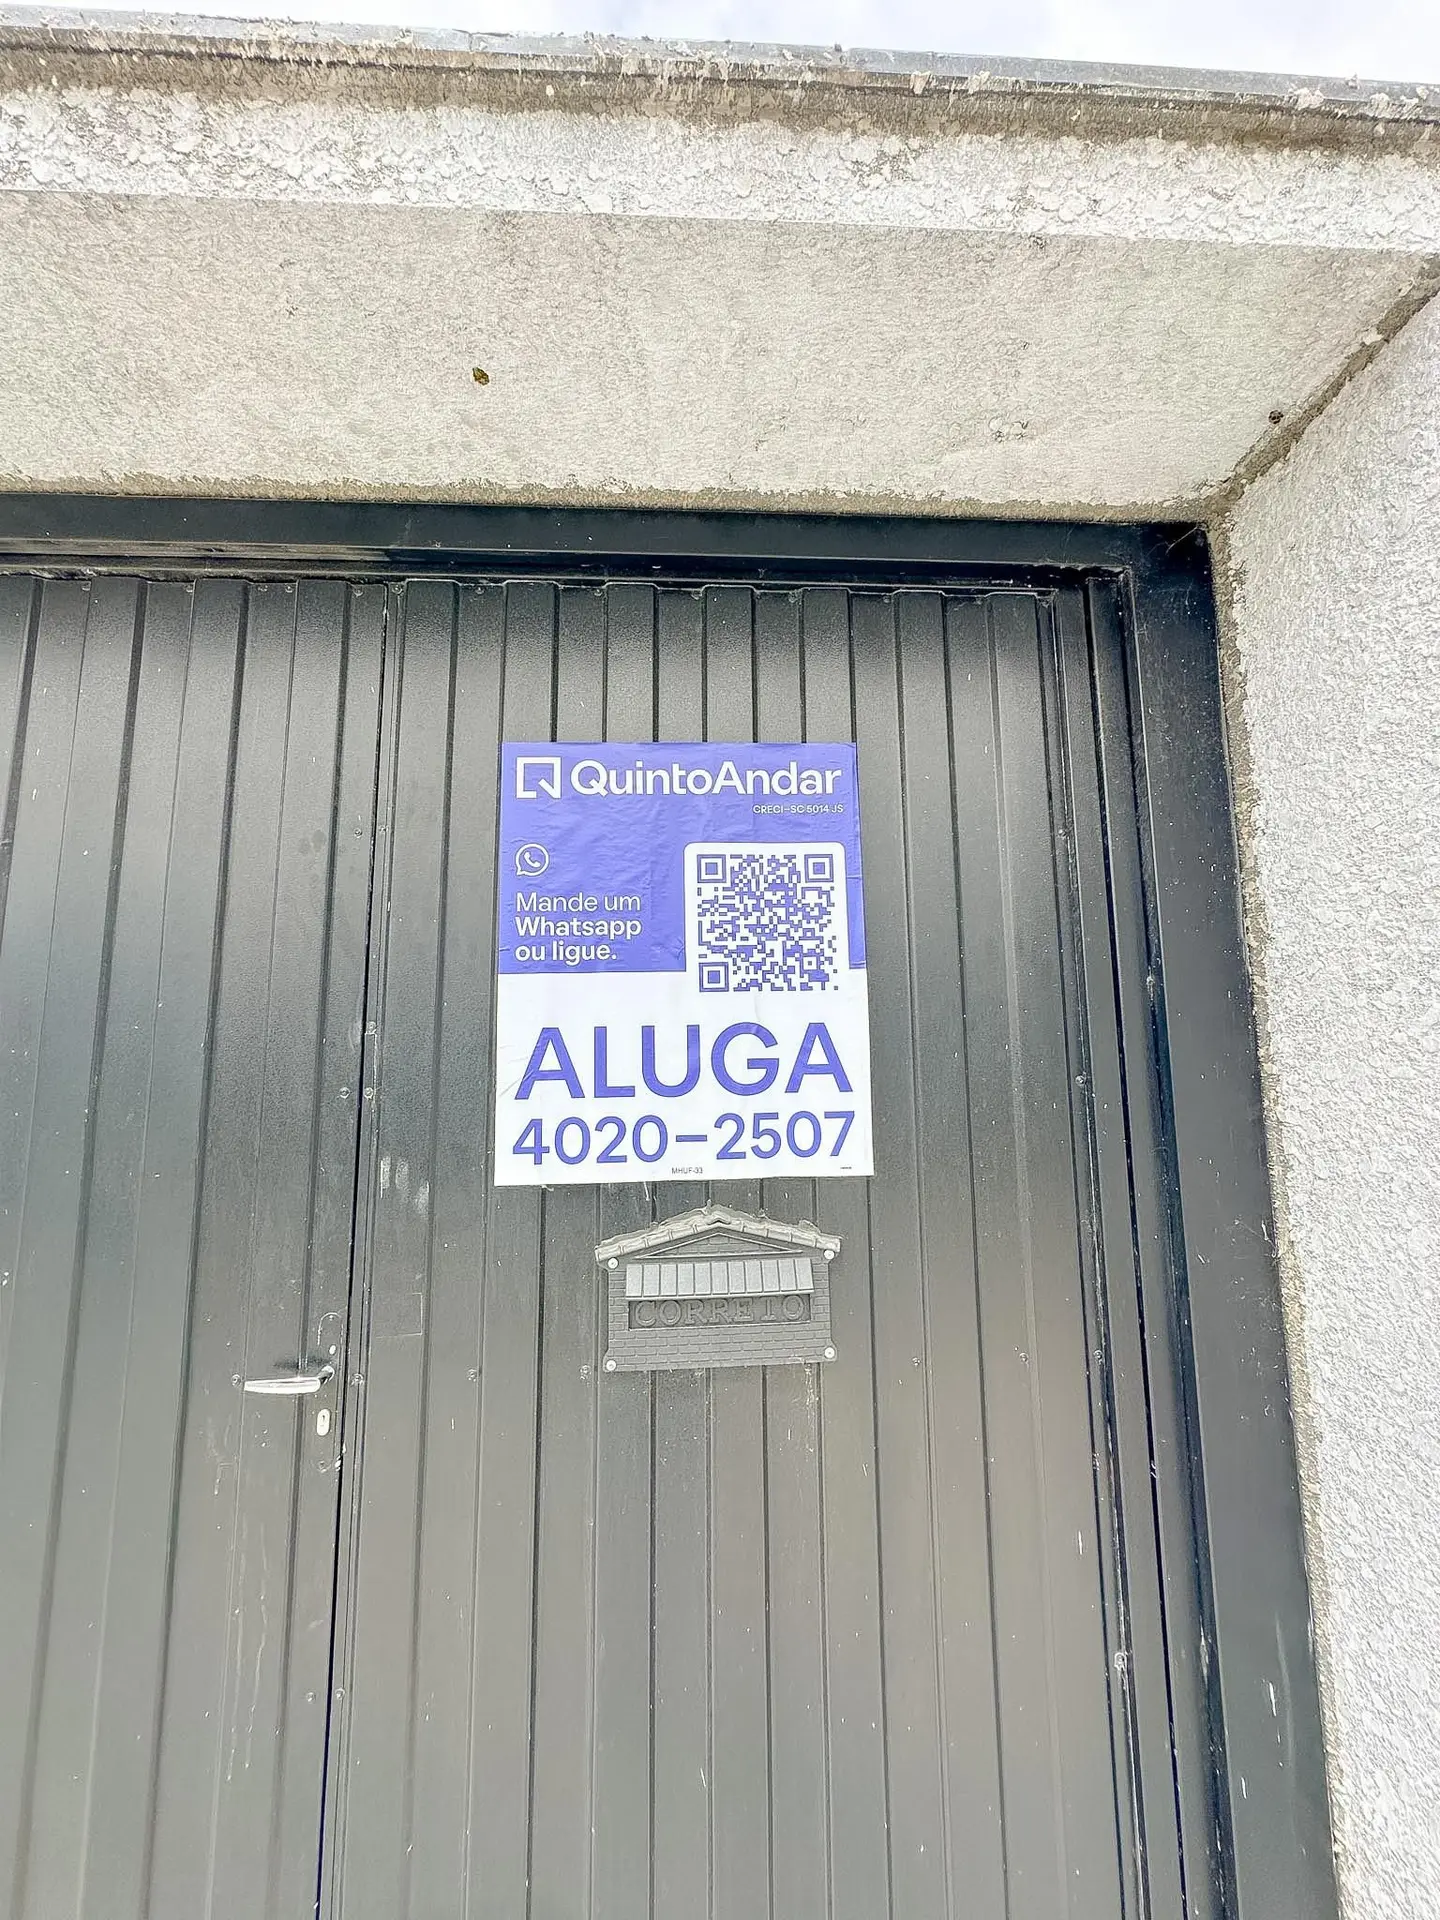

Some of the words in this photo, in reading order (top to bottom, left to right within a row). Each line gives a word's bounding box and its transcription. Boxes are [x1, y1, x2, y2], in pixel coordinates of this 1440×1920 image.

[570, 760, 842, 797] QuintoAndar
[806, 804, 829, 814] 5014
[832, 803, 844, 813] JS
[516, 892, 598, 912] Mande
[604, 895, 641, 911] um
[515, 916, 642, 940] Whatsapp
[515, 945, 545, 961] ou
[552, 941, 617, 966] ligue.
[514, 1021, 853, 1100] ALUGA
[512, 1110, 855, 1165] 4020-2507
[634, 1294, 806, 1327] CORREIO
